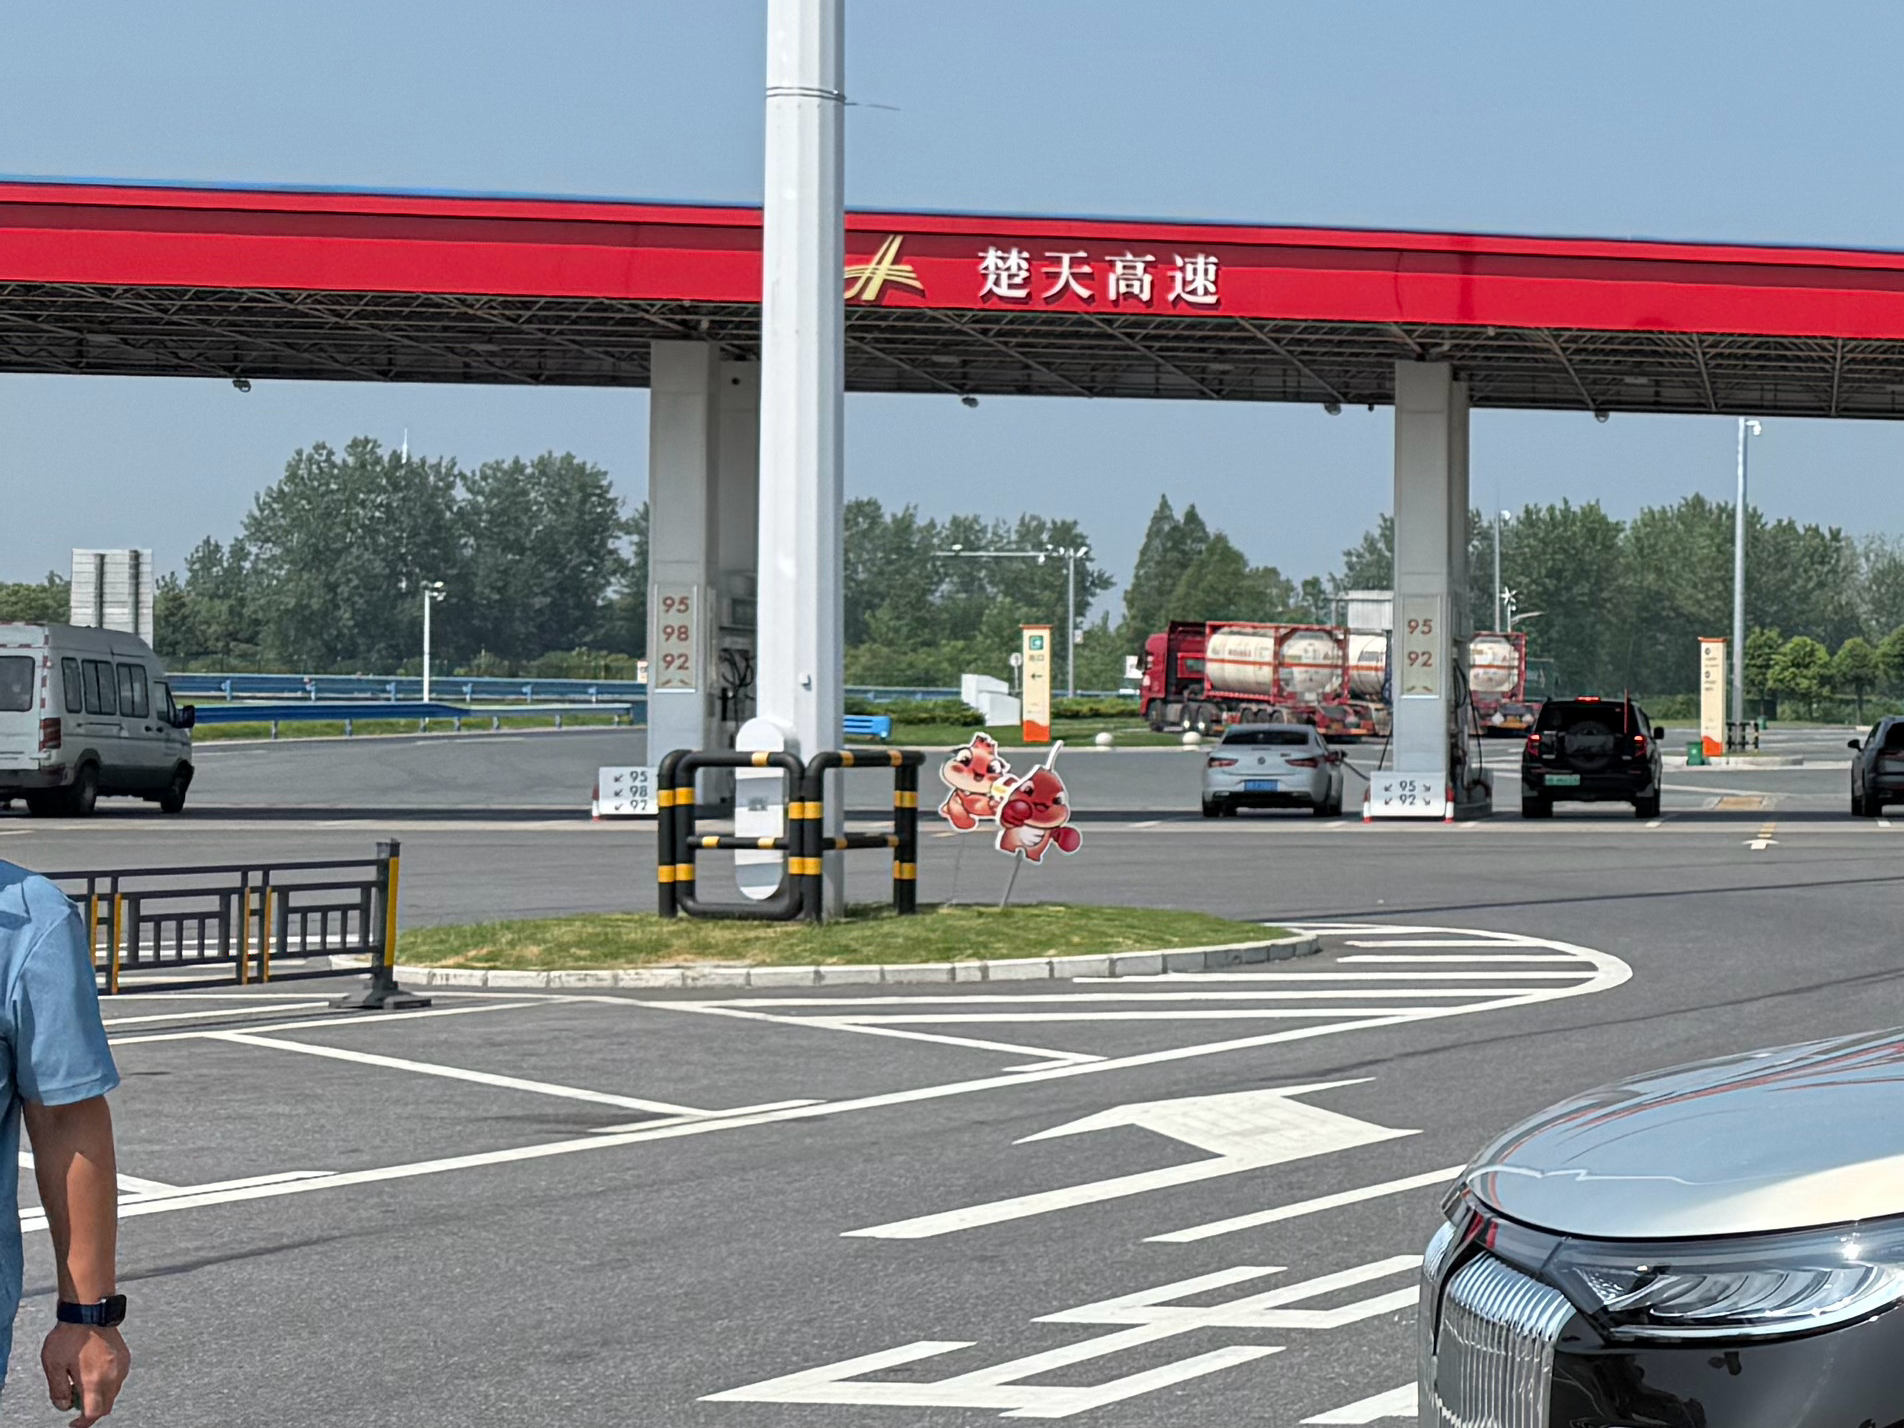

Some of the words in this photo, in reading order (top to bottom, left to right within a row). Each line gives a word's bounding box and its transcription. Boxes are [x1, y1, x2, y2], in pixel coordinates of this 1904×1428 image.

[978, 246, 1220, 305] 楚天高速
[662, 596, 690, 614] 95
[662, 624, 690, 642] 98
[1407, 619, 1433, 635] 95
[662, 653, 690, 671] 92
[1407, 651, 1433, 668] 92
[629, 770, 648, 783] 95
[629, 785, 648, 798] 98
[1399, 780, 1417, 792] 95
[1399, 793, 1417, 806] 92
